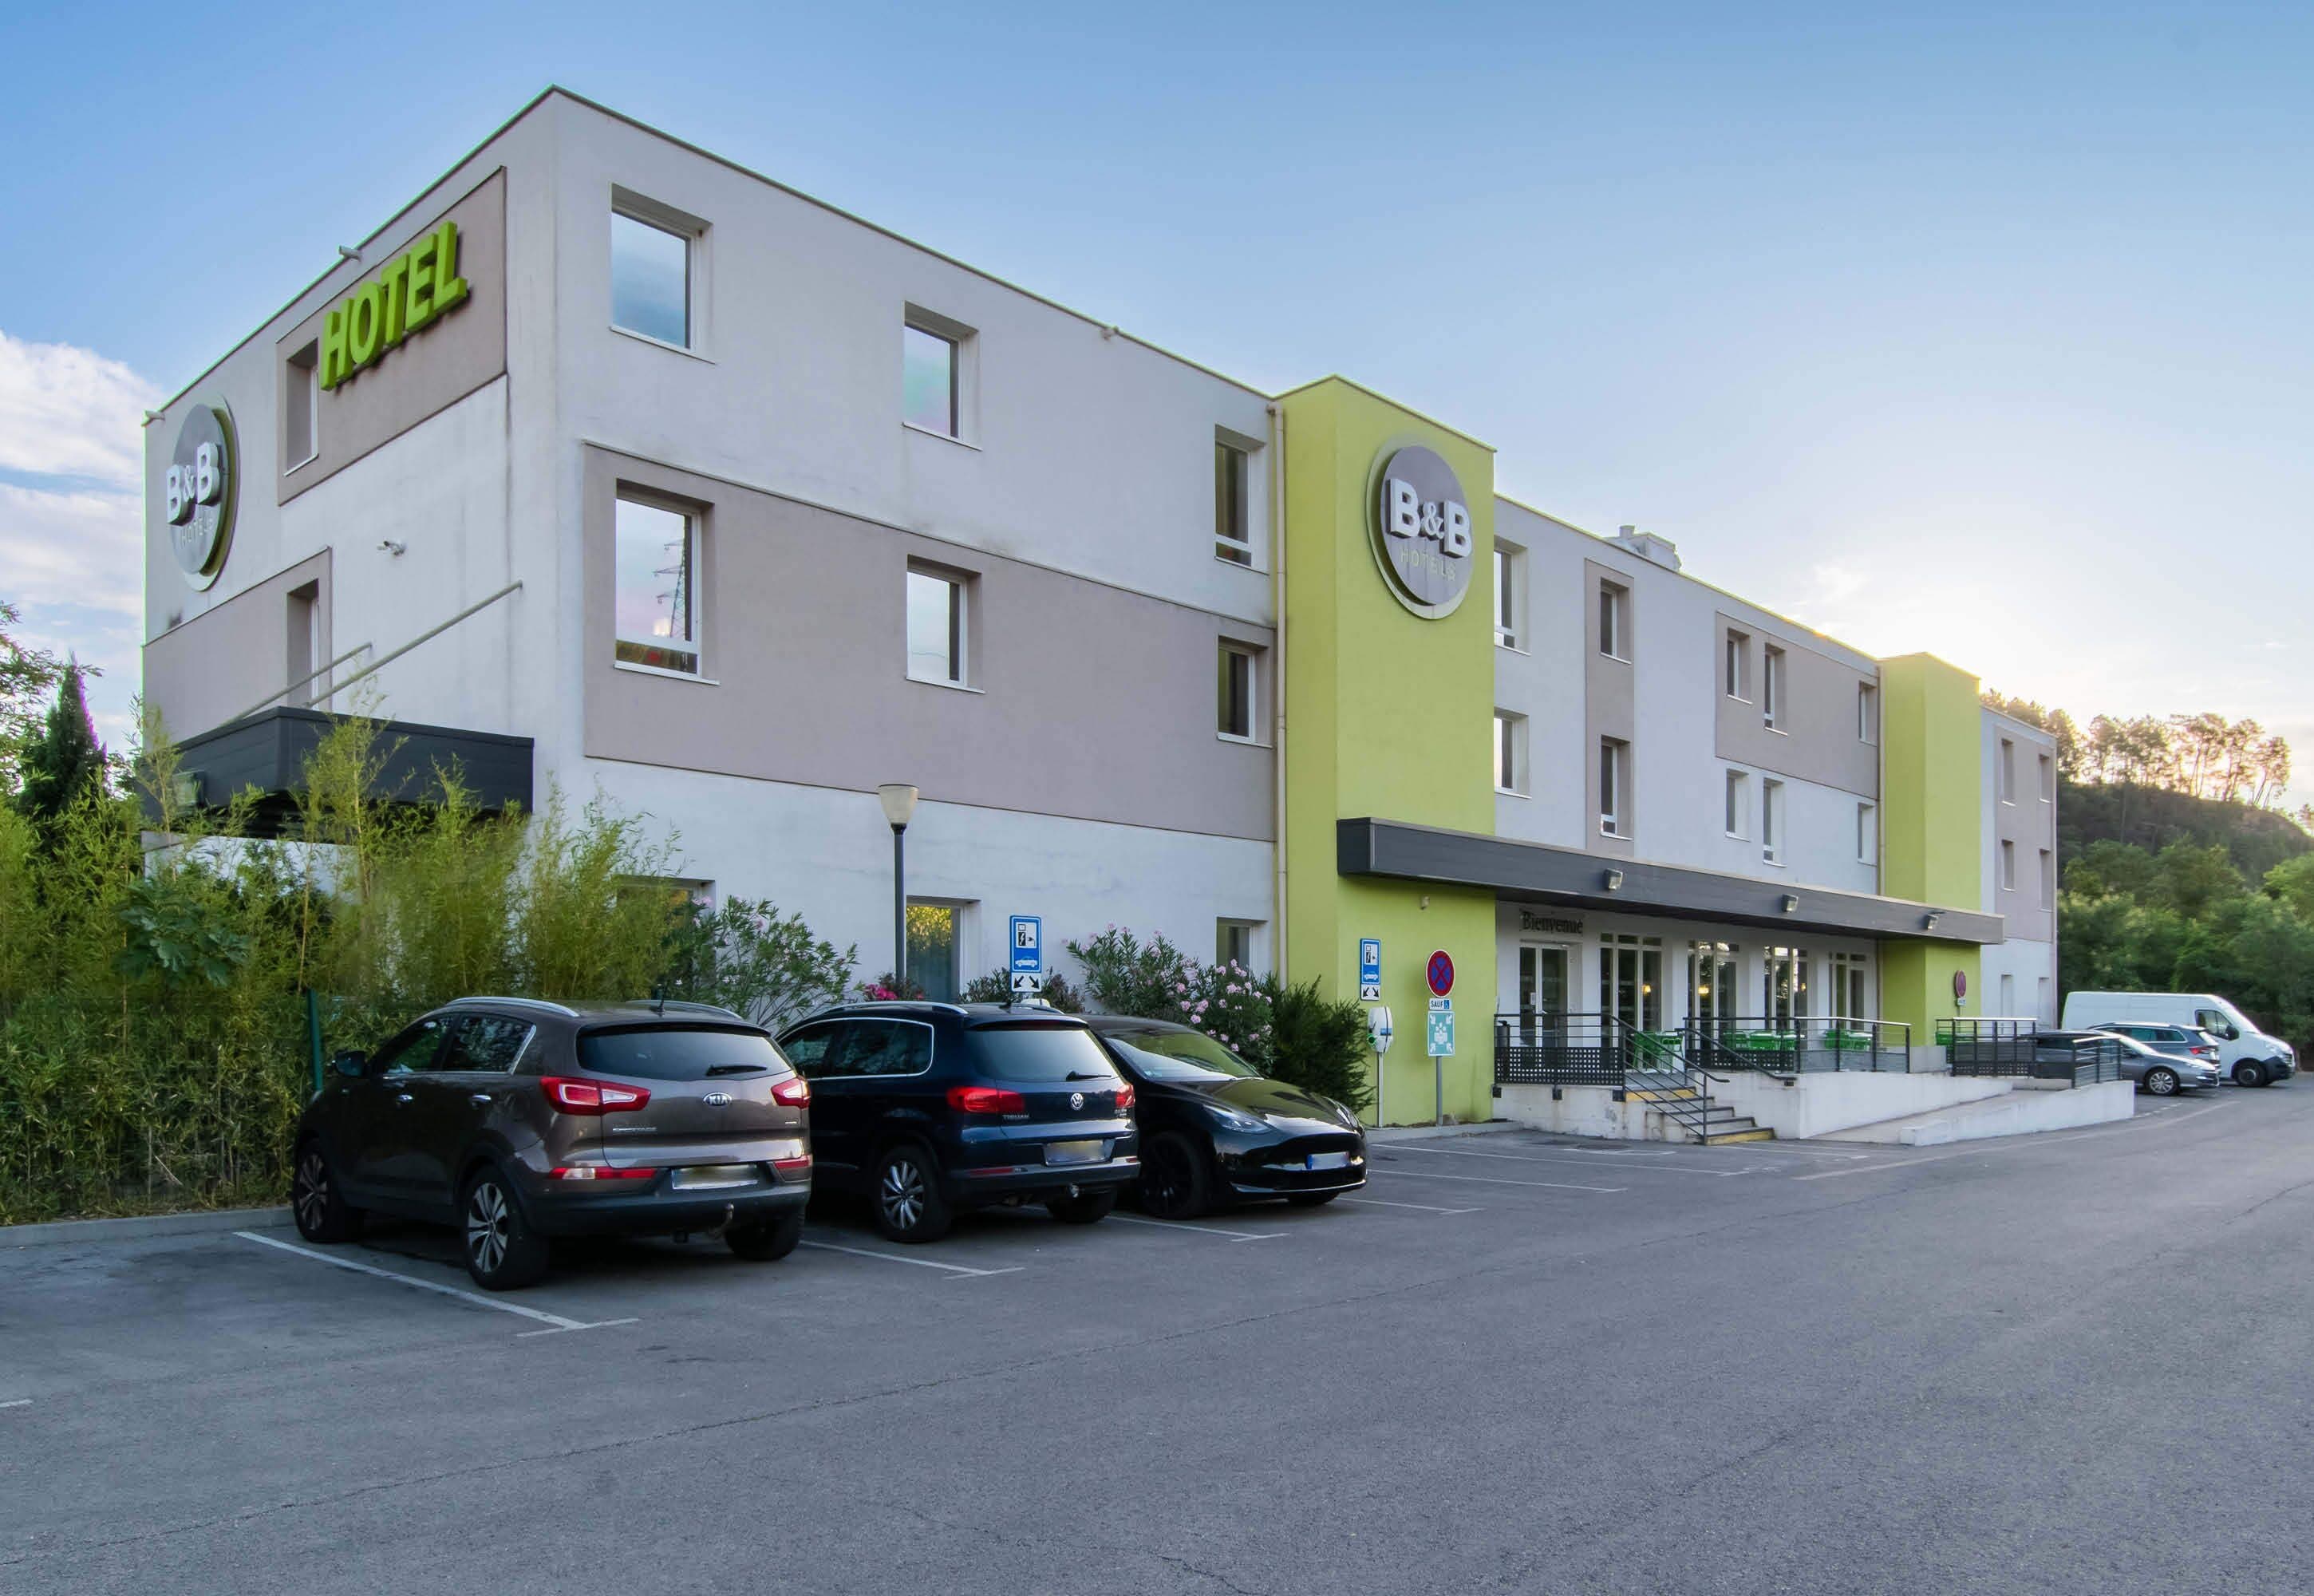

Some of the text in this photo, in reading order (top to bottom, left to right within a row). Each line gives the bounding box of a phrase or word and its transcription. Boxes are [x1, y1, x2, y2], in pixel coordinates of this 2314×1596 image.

[320, 220, 468, 391] HOTEL
[165, 441, 221, 527] B&B
[1385, 478, 1472, 558] B&B
[708, 1096, 728, 1105] KIA
